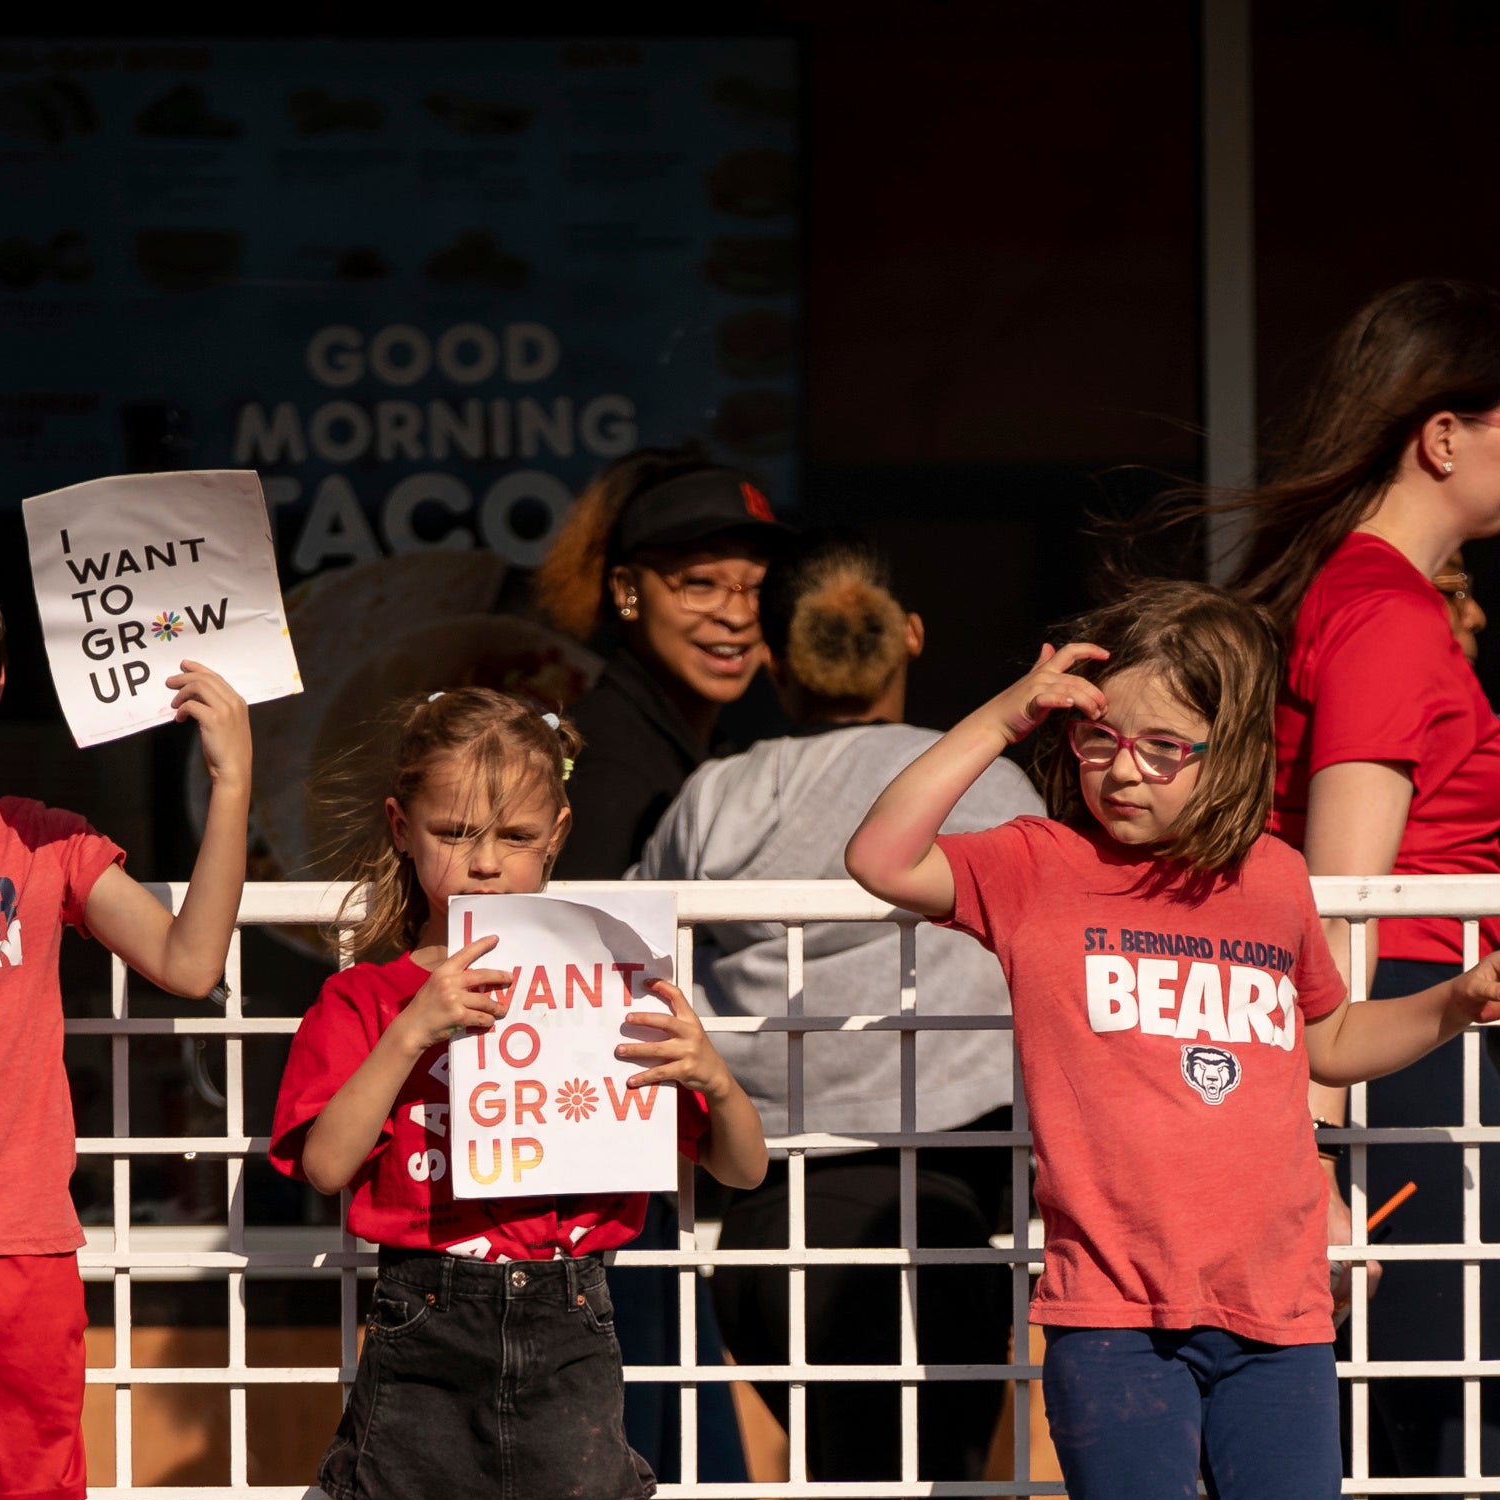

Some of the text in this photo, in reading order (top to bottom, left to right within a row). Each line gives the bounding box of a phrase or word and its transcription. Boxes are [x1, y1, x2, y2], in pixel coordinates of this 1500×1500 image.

[306, 321, 561, 388] GOOD
[233, 394, 640, 465] MORNING
[60, 529, 71, 554] I
[66, 537, 205, 584] WANT
[71, 584, 134, 623] TO
[89, 660, 151, 704] UP
[463, 911, 473, 946] I
[1084, 927, 1115, 951] ST.
[1120, 928, 1214, 959] BERNARD
[1084, 954, 1299, 1052] BEARS
[466, 1022, 541, 1070] TO
[468, 1137, 544, 1185] UP
